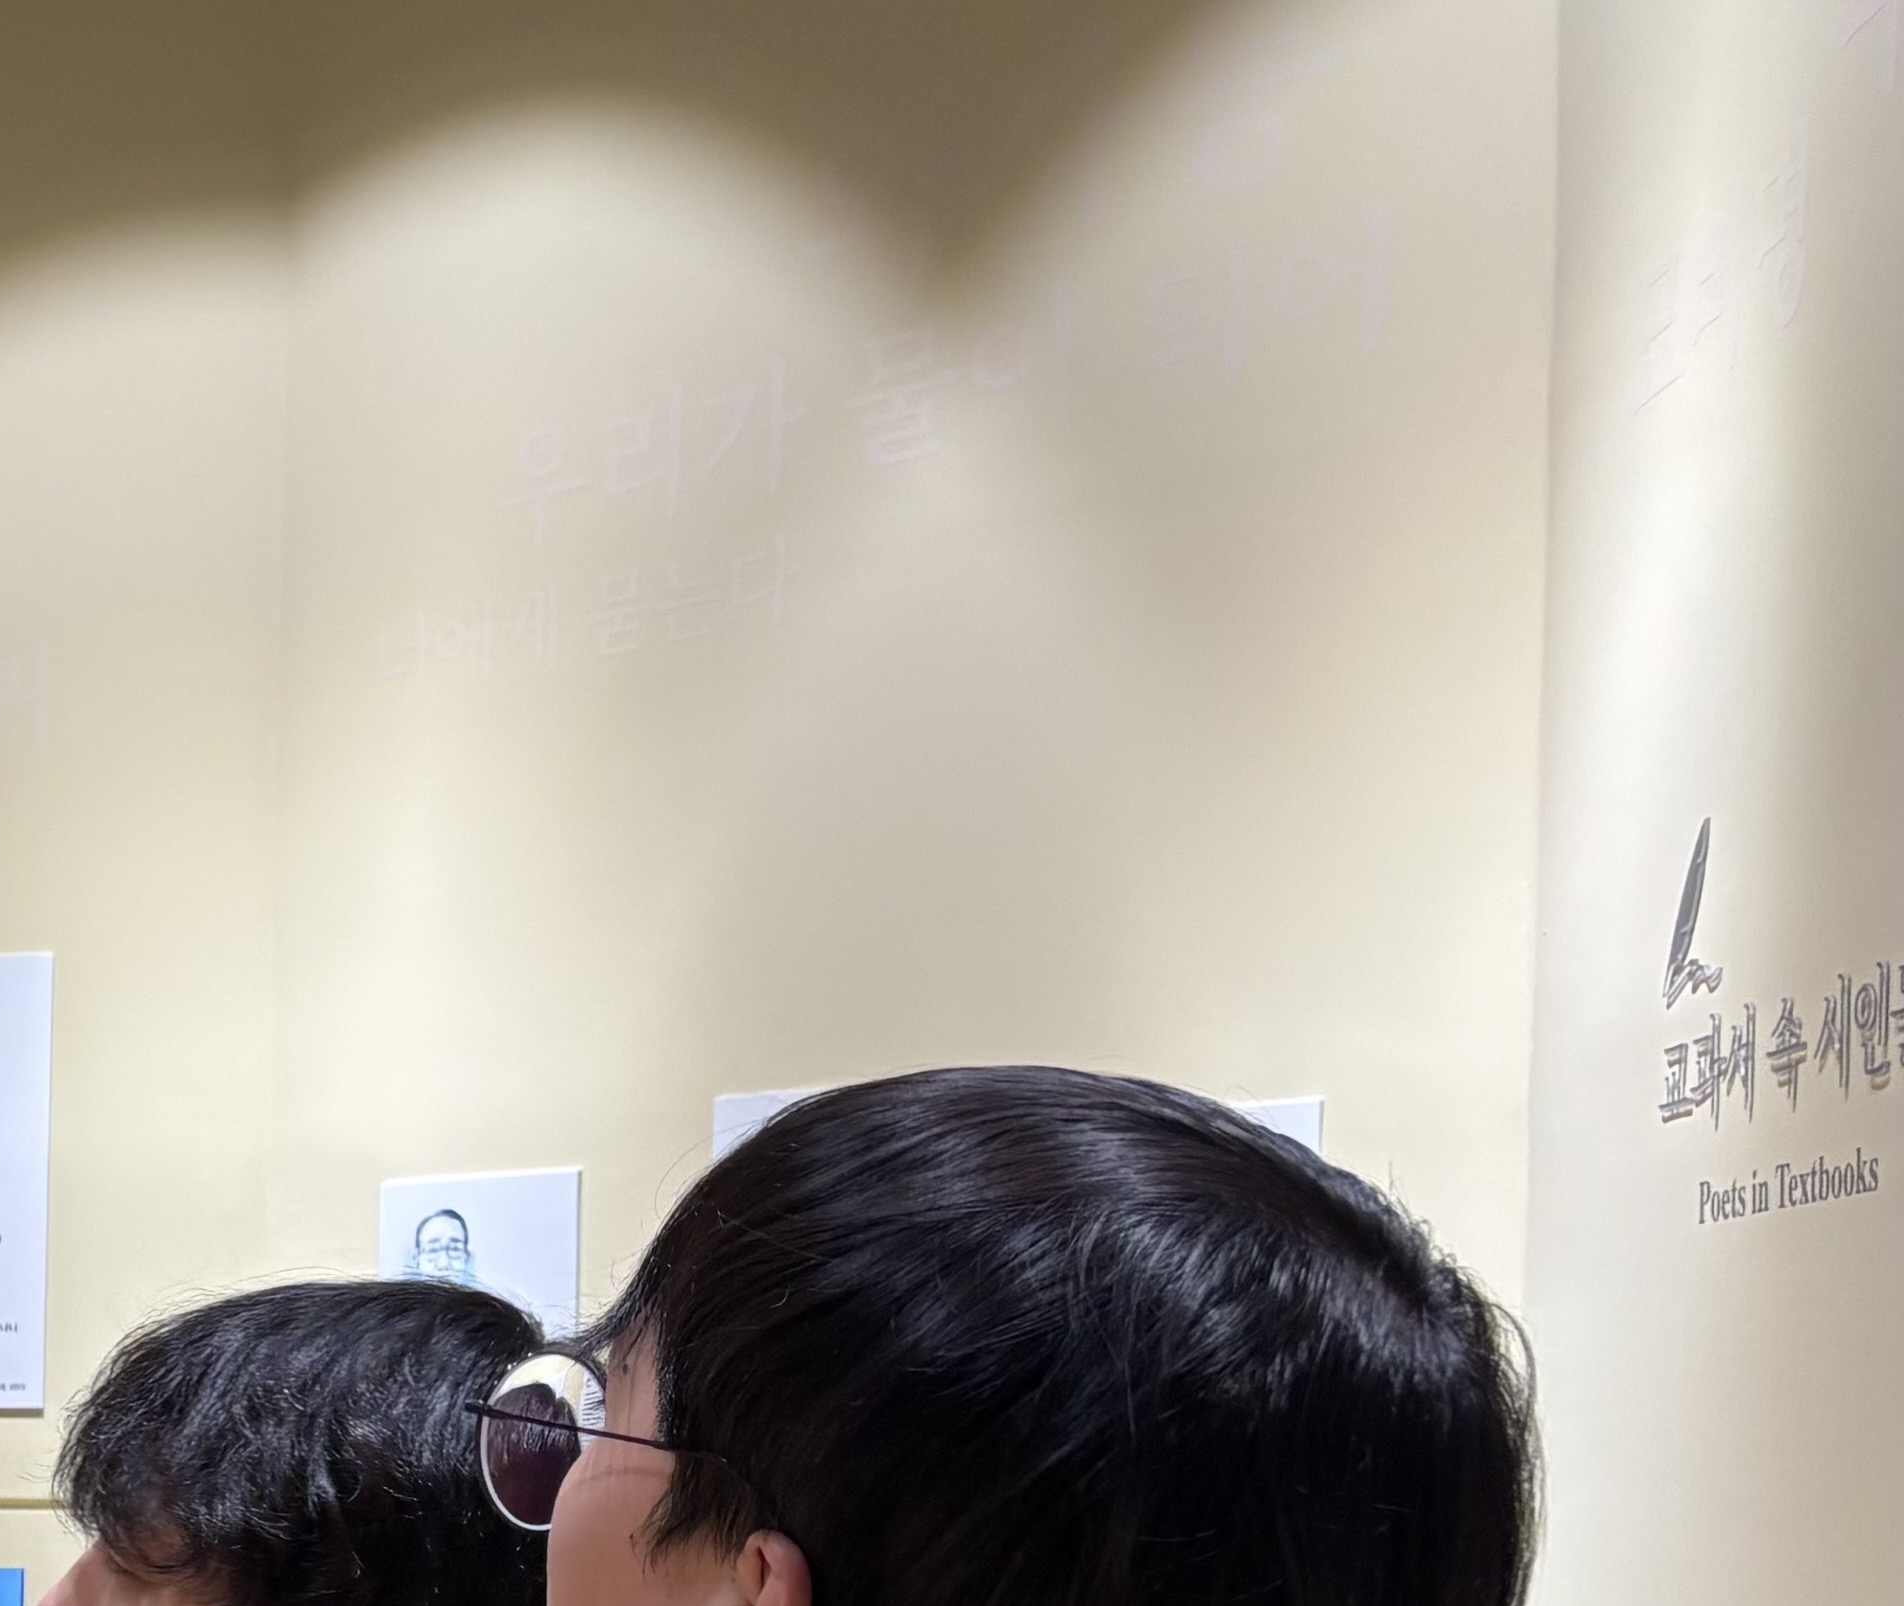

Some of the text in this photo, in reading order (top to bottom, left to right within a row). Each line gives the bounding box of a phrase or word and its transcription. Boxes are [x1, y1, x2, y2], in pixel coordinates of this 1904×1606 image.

[1658, 1002, 1757, 1131] 교과서
[1765, 997, 1808, 1114] 속
[1698, 1146, 1880, 1225] Poets in Textbooks
